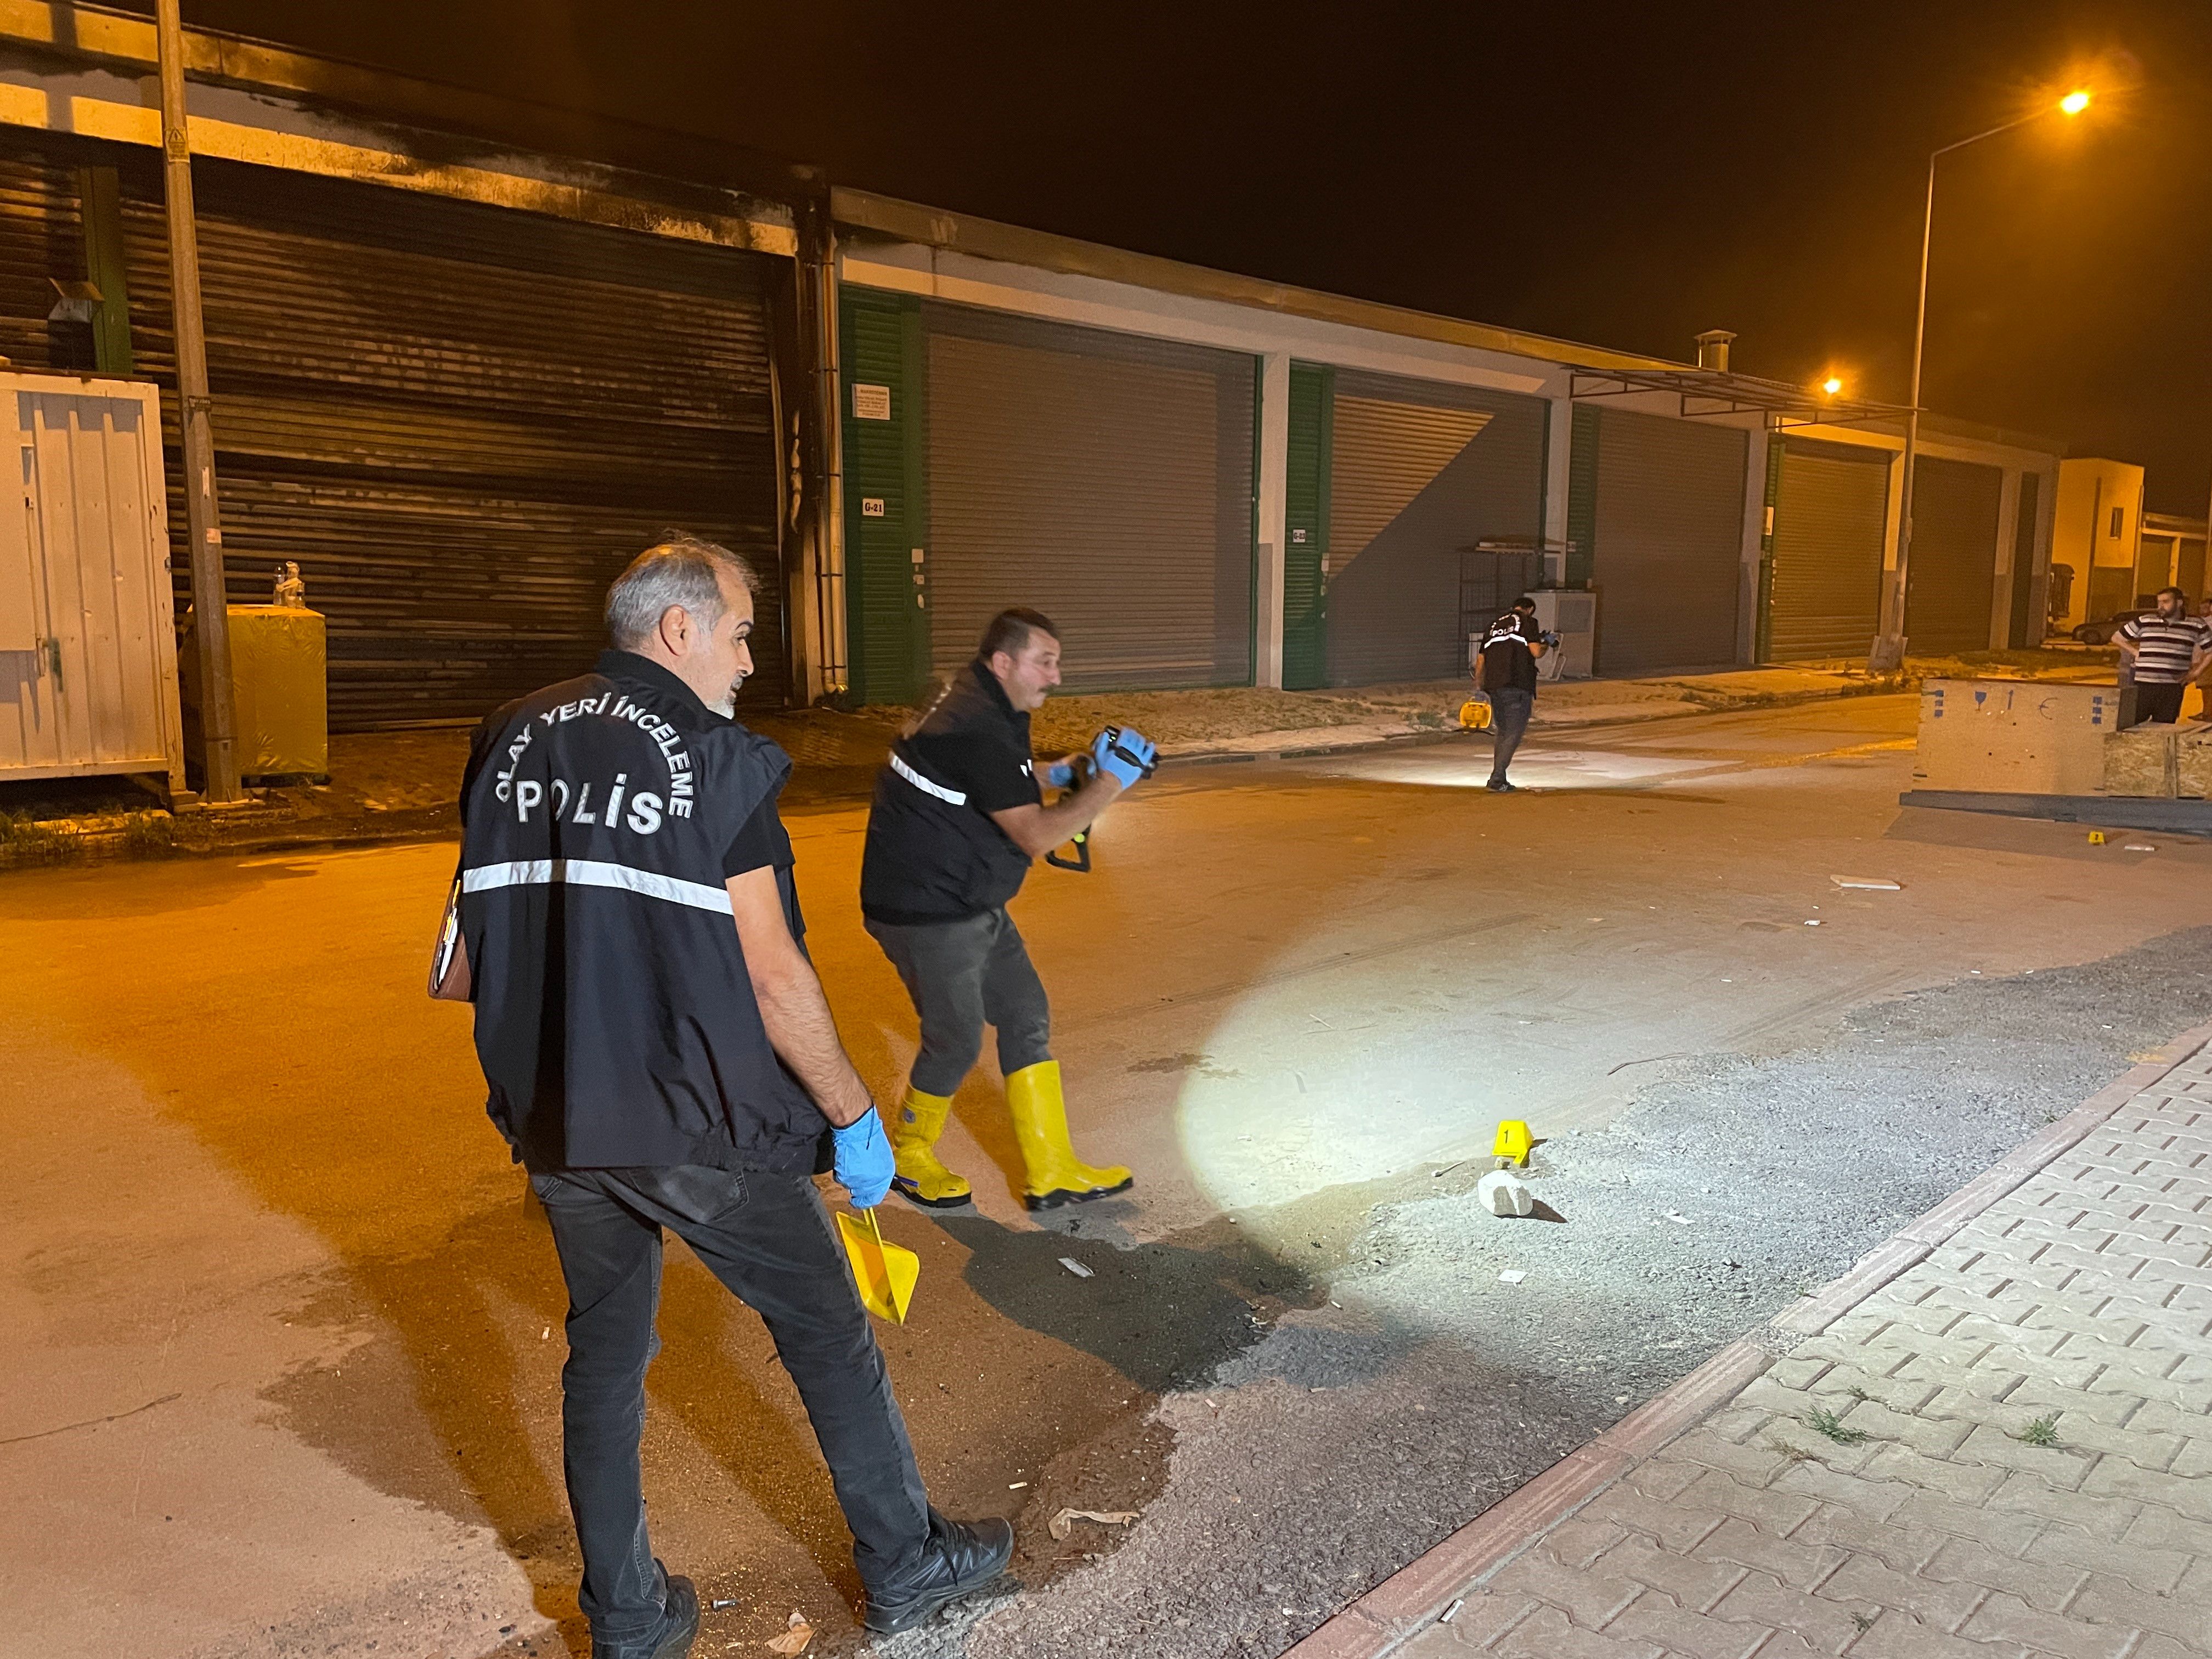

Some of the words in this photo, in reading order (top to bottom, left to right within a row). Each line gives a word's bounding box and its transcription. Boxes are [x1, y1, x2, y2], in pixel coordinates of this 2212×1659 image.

[865, 502, 882, 512] G-21
[495, 723, 532, 803] OLAY
[539, 692, 612, 727] YERİ
[611, 695, 694, 819] İNCELEME
[516, 773, 663, 835] POLİS
[1504, 1129, 1509, 1144] 1
